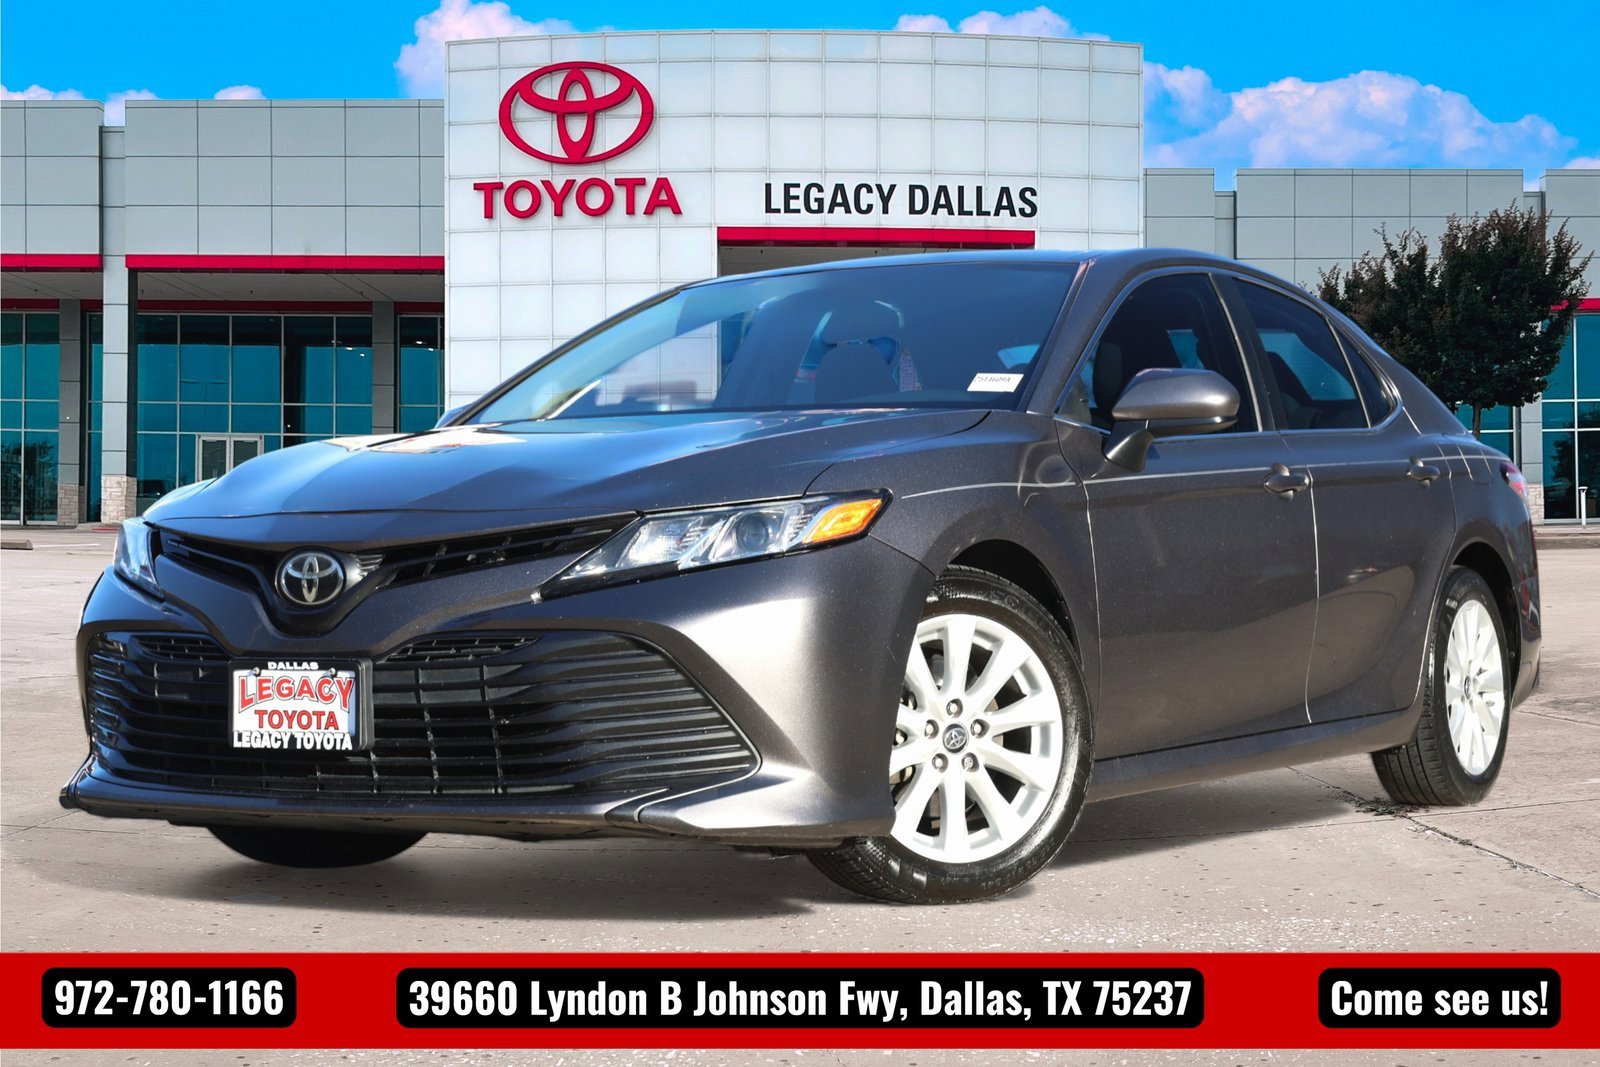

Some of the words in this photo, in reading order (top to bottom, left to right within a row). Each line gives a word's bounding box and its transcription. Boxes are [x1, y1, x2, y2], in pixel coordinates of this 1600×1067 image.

[473, 177, 682, 219] TOYOTA
[765, 183, 897, 215] LEGACY
[908, 185, 1038, 218] DALLAS
[267, 661, 320, 671] DALLAS
[239, 675, 355, 713] LEGACY
[254, 709, 339, 730] TOYOTA
[233, 730, 291, 749] LEGACY
[294, 731, 353, 751] TOYOTA
